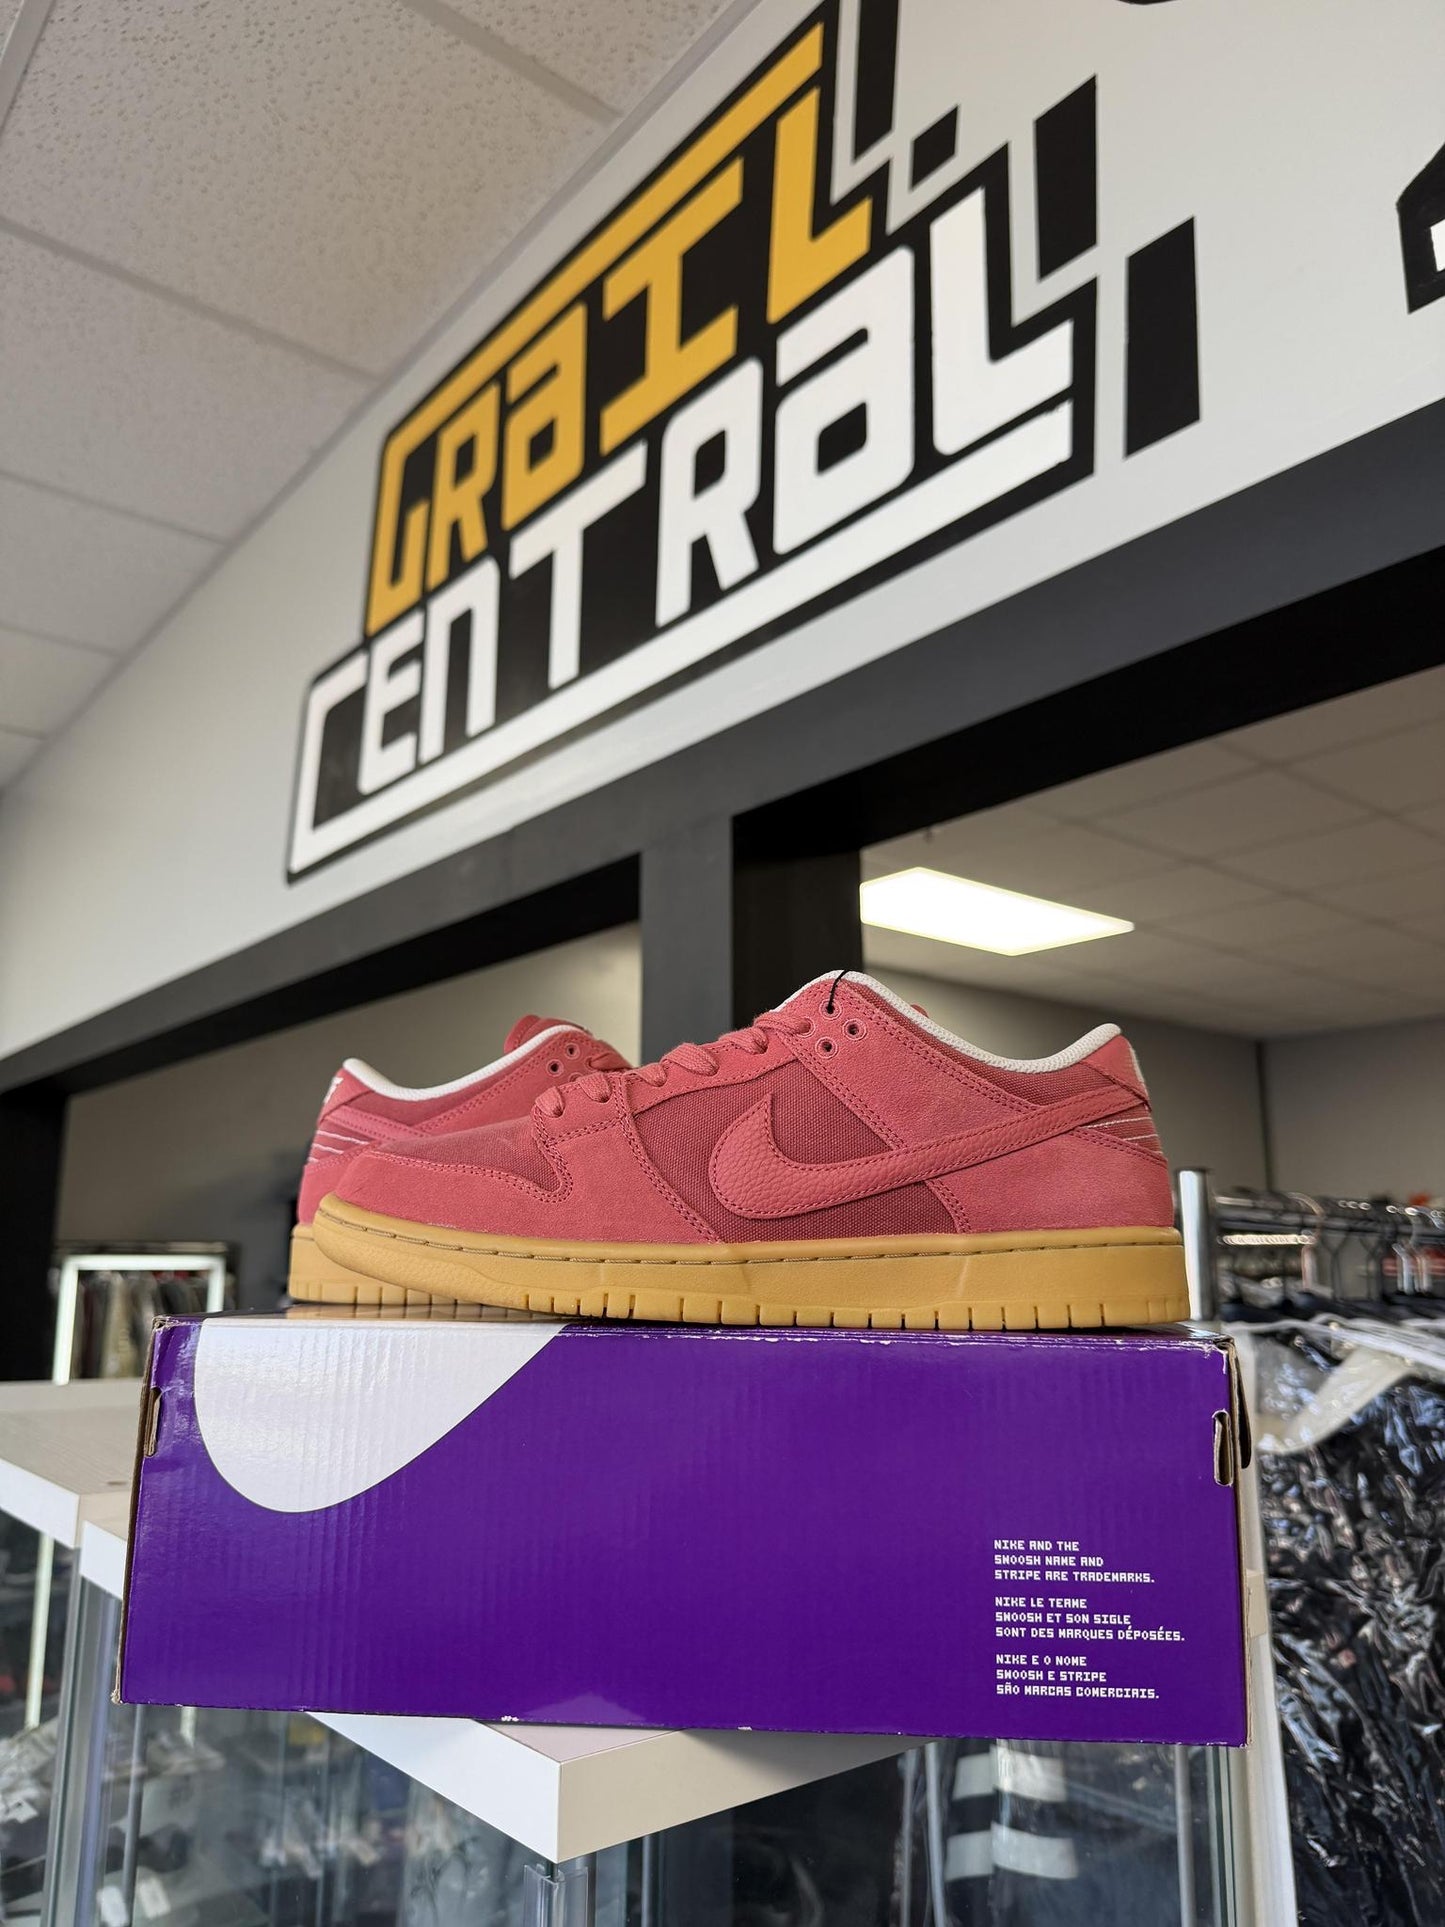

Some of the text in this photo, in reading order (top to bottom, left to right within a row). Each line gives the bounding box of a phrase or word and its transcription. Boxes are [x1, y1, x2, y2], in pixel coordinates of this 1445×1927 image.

[994, 1539, 1079, 1552] NIKE AND THE
[995, 1554, 1103, 1567] SWOOSH NAME AND
[995, 1569, 1155, 1584] STRIPE ARE TRADEMARKS.
[995, 1596, 1026, 1608] NIKE
[1031, 1597, 1044, 1608] LE
[996, 1611, 1131, 1626] SWOOSH ET SON SIGLE
[996, 1625, 1185, 1642] SONT DES MARQUES DÉPOSÉES.
[996, 1653, 1087, 1667] NIKE E O NOME
[997, 1669, 1107, 1683] SWOOSH E STRIPE
[997, 1681, 1160, 1700] SÃO MARCAS COMERCIAIS.
